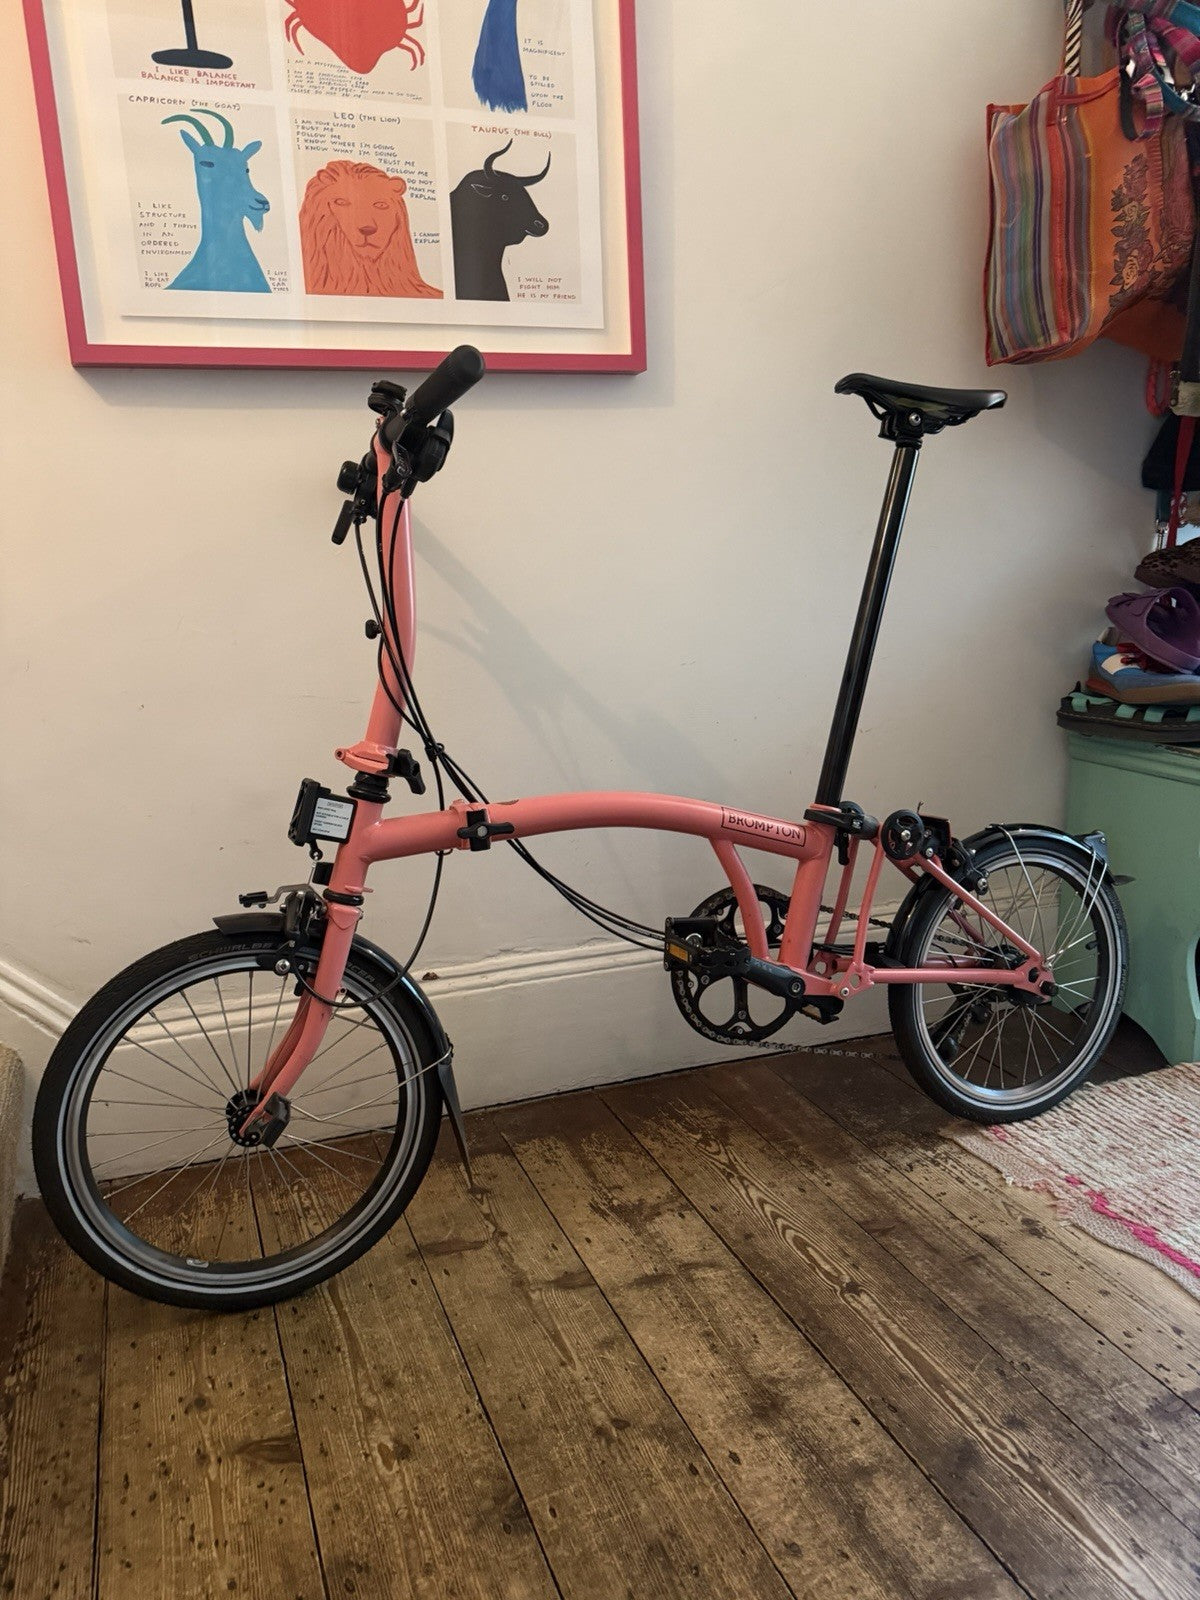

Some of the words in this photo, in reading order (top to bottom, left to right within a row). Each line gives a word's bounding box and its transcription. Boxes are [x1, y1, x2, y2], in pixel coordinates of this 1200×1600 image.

[141, 71, 184, 83] BALANCE
[206, 79, 256, 90] IMPORTANT
[169, 68, 190, 76] LIKE
[197, 70, 238, 81] BALANCE
[128, 95, 186, 105] CAPRICORN
[191, 99, 208, 107] (THE
[333, 112, 355, 120] LEO
[359, 113, 376, 123] (THE
[380, 115, 401, 124] LION)
[471, 125, 510, 135] TAURUS
[513, 128, 530, 136] (THE
[533, 131, 552, 139] BULL)
[331, 140, 355, 148] WHERE
[373, 143, 395, 151] GOING
[375, 150, 398, 158] DOING
[386, 167, 415, 175] FOLLOW
[139, 211, 186, 219] STRUCTURE
[728, 814, 801, 839] BROMPTON
